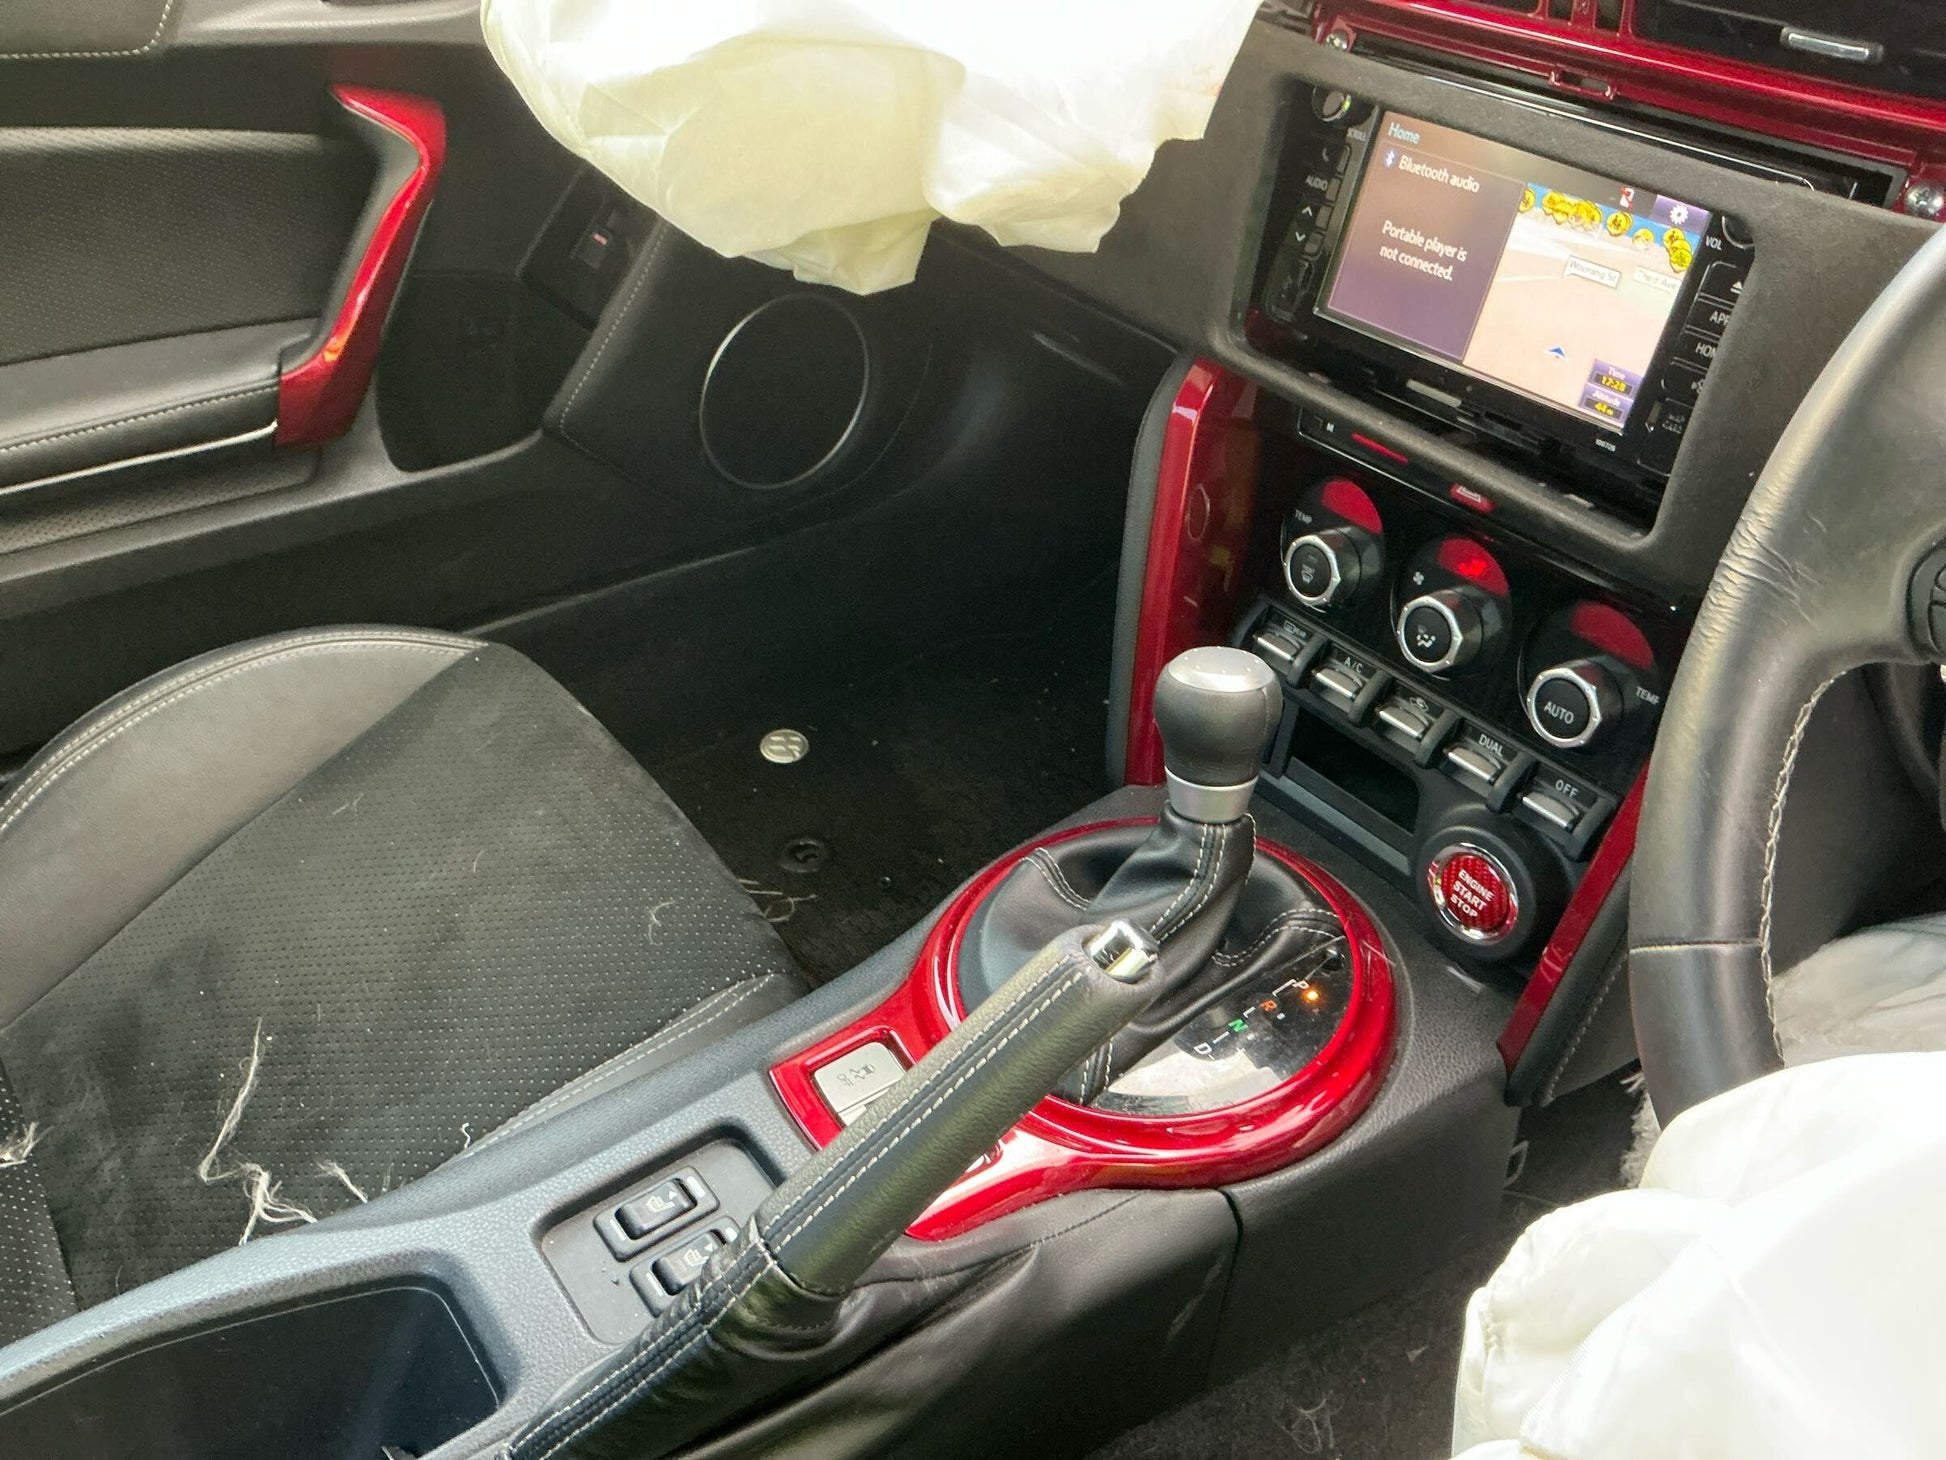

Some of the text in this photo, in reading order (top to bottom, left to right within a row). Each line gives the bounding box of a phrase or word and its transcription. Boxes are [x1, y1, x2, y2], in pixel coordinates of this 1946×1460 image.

[1388, 122, 1420, 144] Home
[1305, 175, 1329, 191] AUDIO
[1398, 155, 1480, 193] Bluetooth audio
[1382, 220, 1468, 262] Portable player is
[1705, 236, 1722, 250] VOL
[1379, 245, 1453, 281] not connected.
[1709, 311, 1730, 325] APP
[1294, 508, 1313, 526] TEMP
[1344, 657, 1363, 674] A/C
[1543, 701, 1575, 725] AUTO
[1478, 734, 1503, 757] DUAL
[1555, 780, 1579, 798] OFF
[1458, 869, 1495, 902] ENGINE
[1453, 880, 1487, 910] START
[1450, 893, 1478, 917] STOP
[1292, 980, 1310, 989] P
[1260, 1000, 1278, 1012] R
[1228, 1018, 1248, 1033] N
[1193, 1042, 1213, 1055] D
